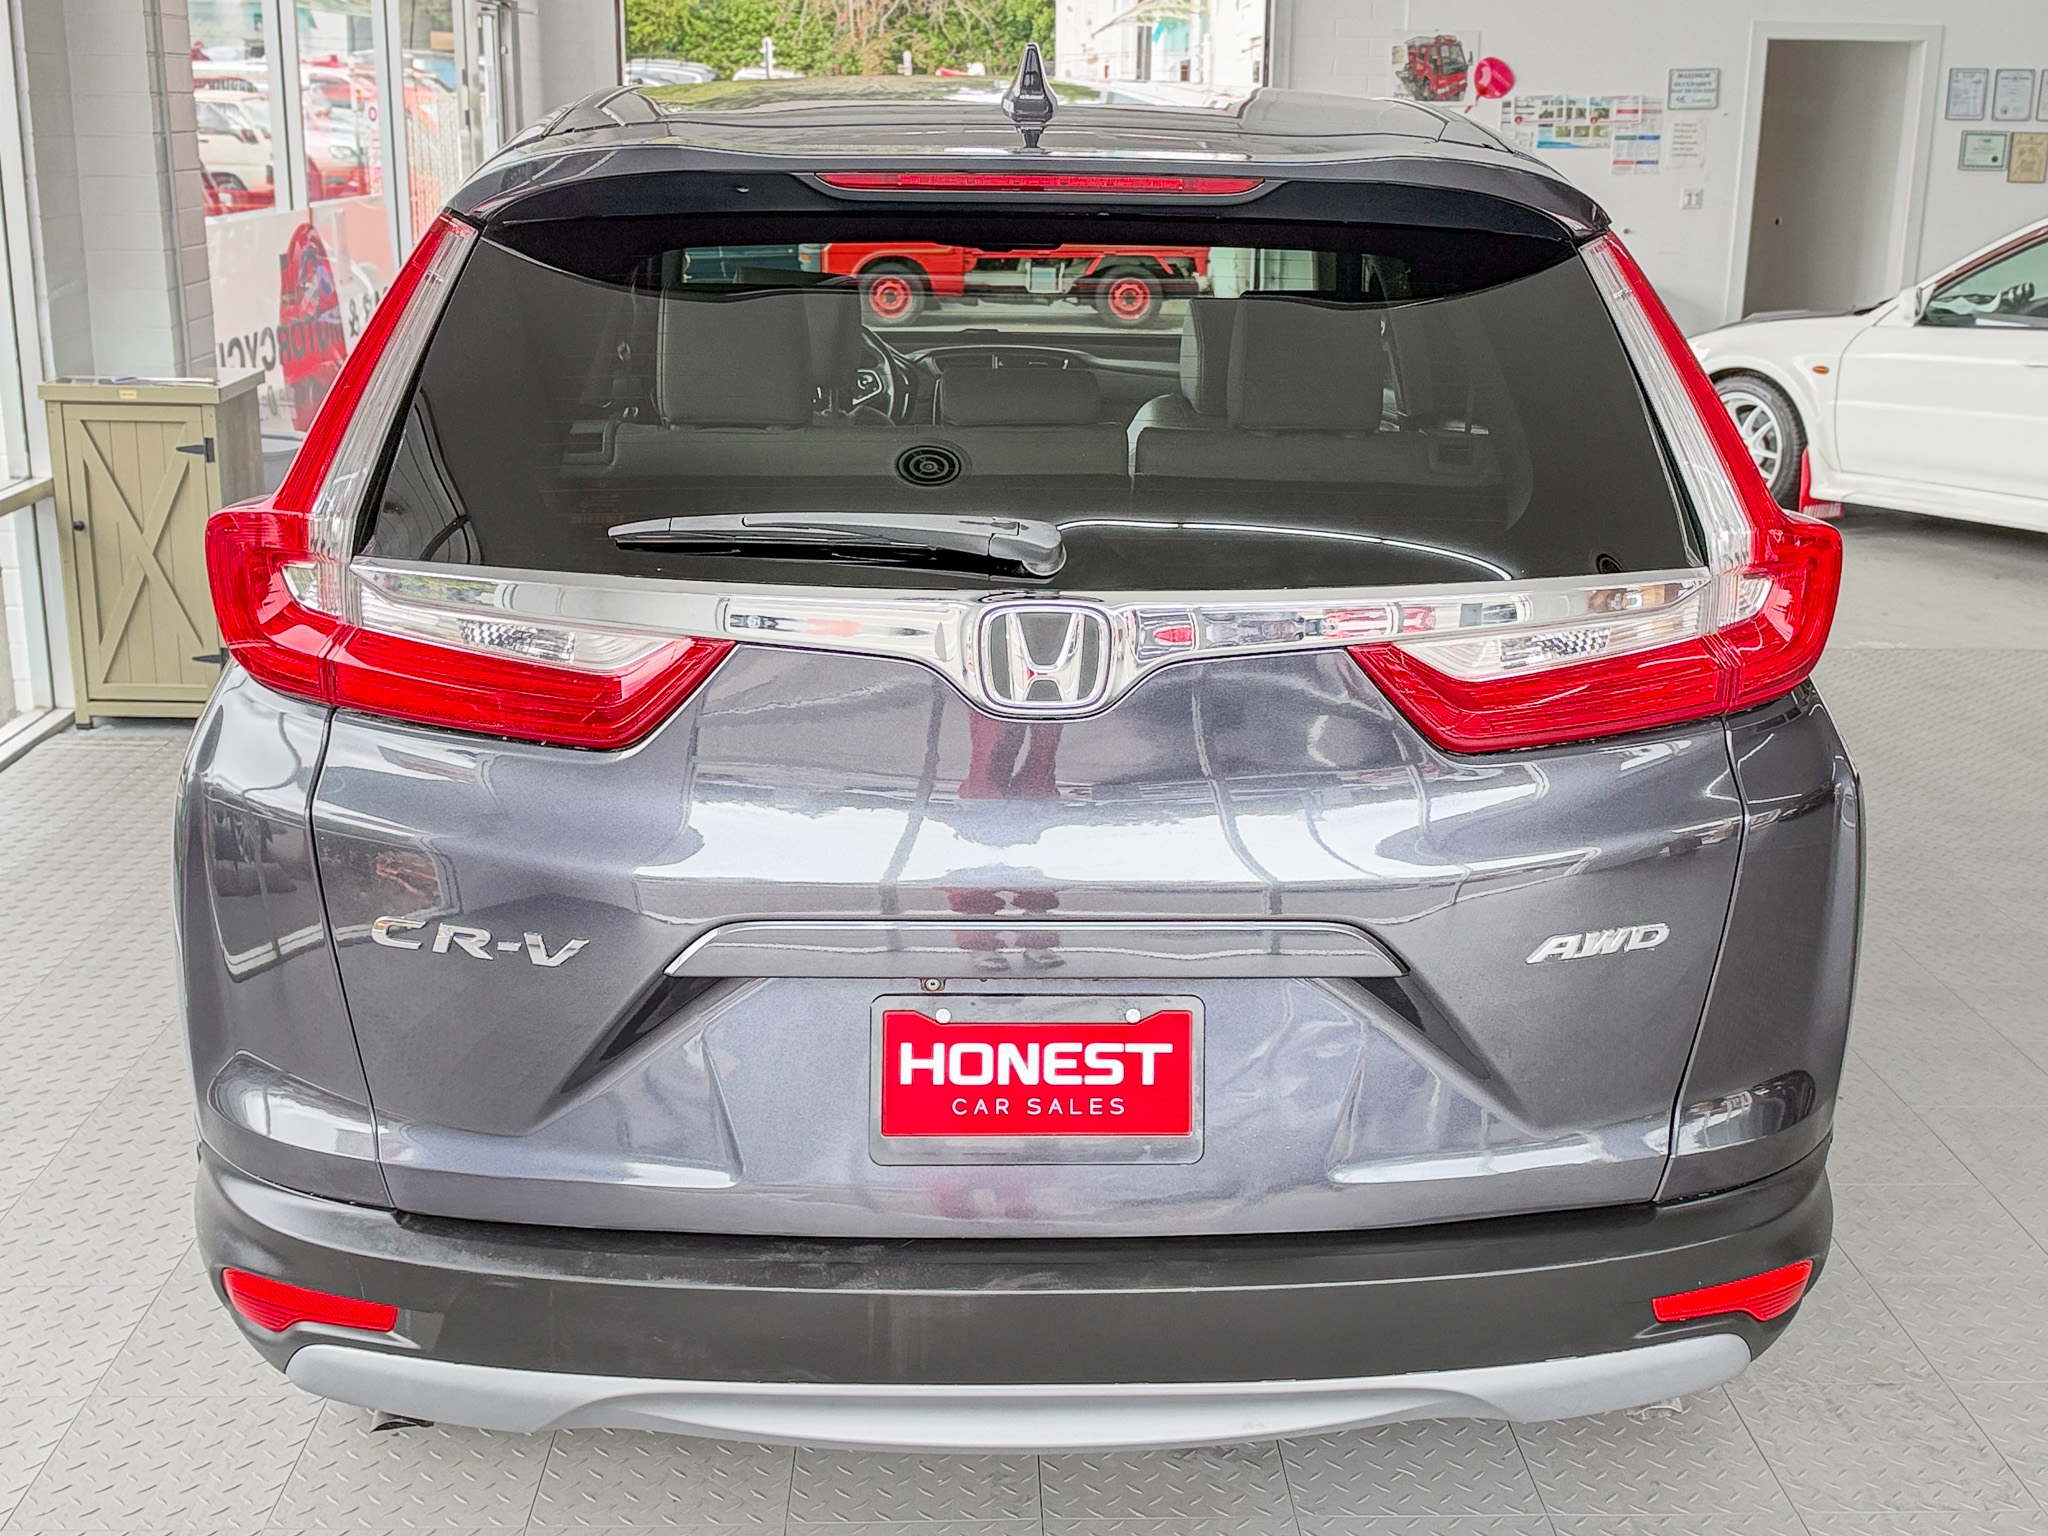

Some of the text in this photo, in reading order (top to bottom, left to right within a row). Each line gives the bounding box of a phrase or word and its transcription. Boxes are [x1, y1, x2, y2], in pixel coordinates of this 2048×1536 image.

[371, 915, 590, 967] CR-V
[1525, 922, 1671, 965] AWD
[899, 1042, 1173, 1086] HONEST
[951, 1098, 1126, 1116] CAR SALES
